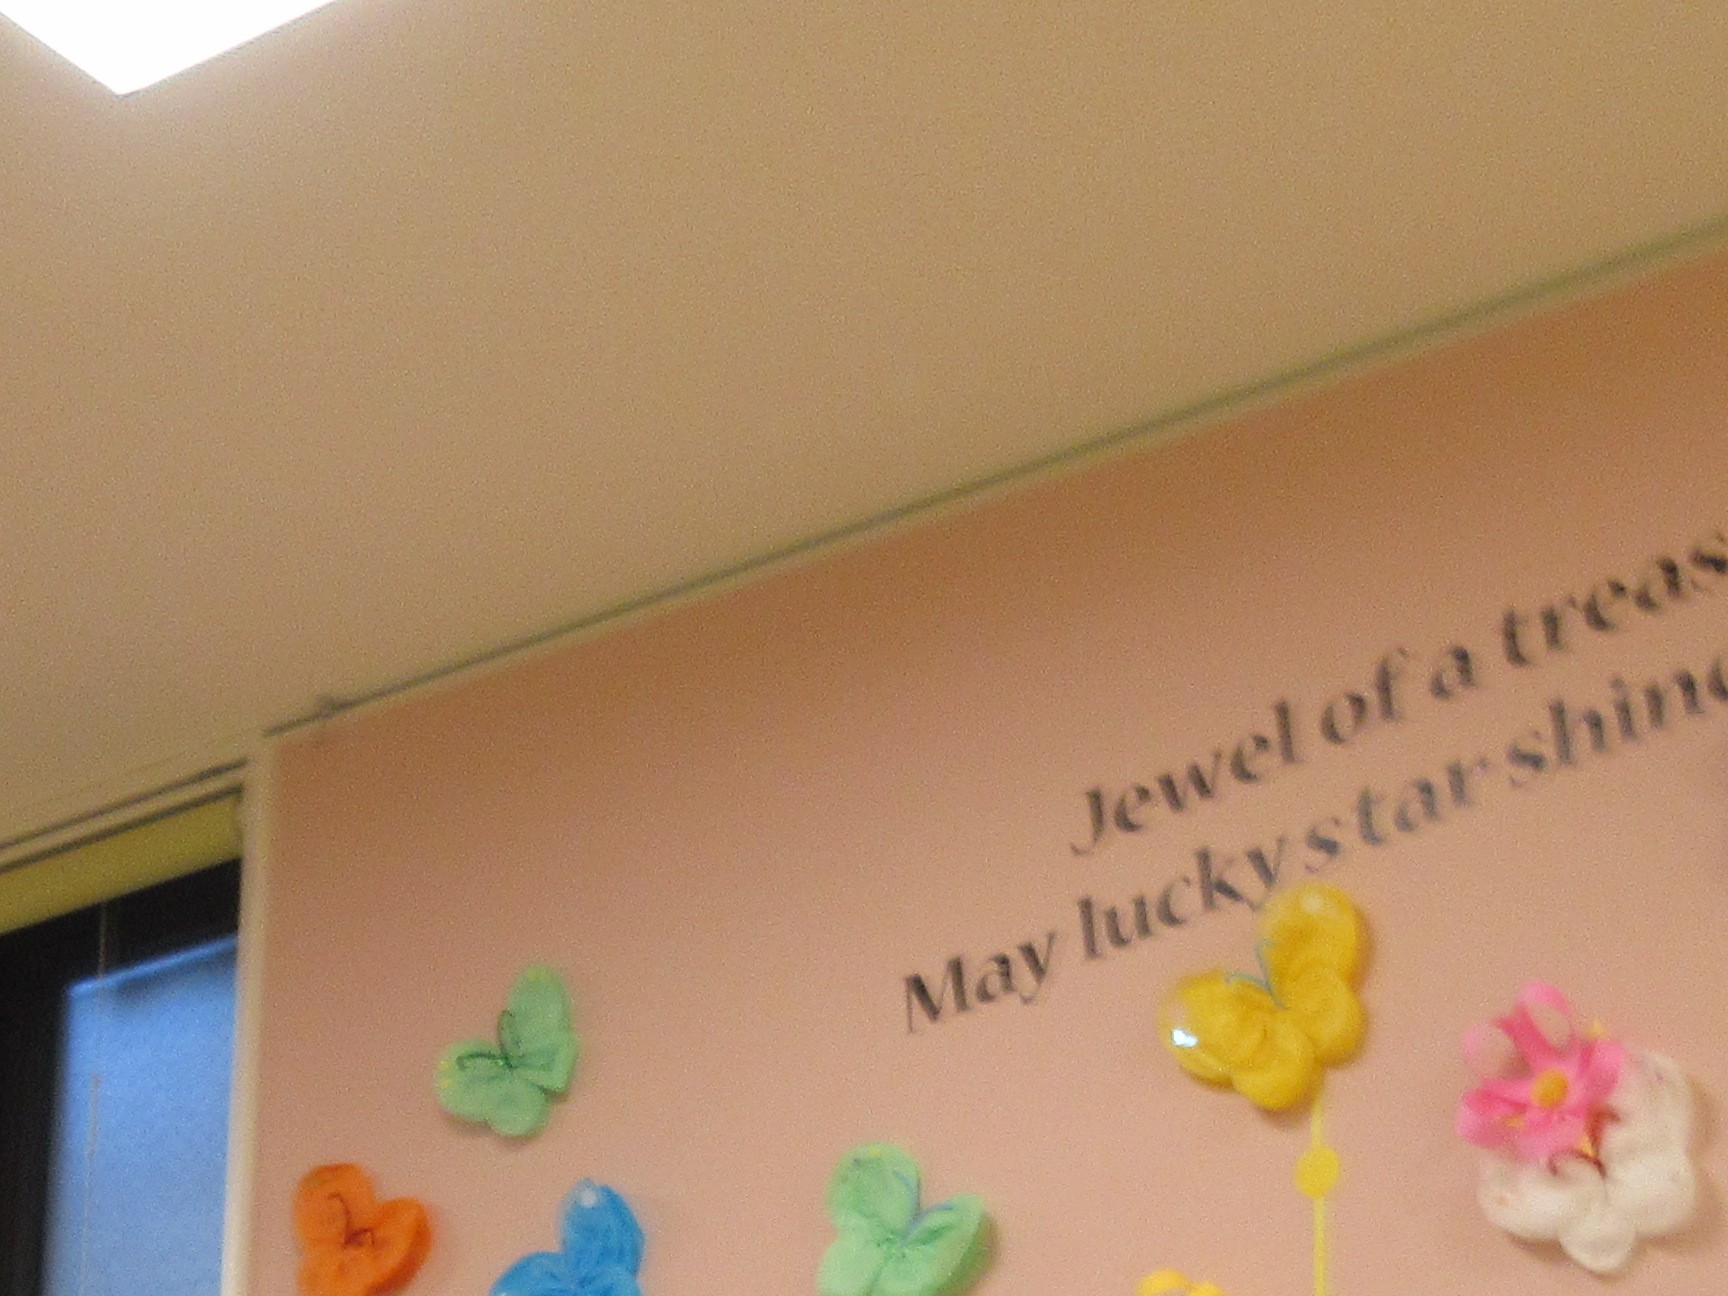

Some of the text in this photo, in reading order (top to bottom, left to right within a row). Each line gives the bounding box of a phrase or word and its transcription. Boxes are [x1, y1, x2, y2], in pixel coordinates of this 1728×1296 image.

[1072, 698, 1303, 856] Jewel
[1321, 647, 1410, 746] of
[1429, 645, 1476, 700] a
[903, 930, 1058, 1034] May
[1077, 835, 1287, 961] lucky
[1304, 756, 1492, 874] star
